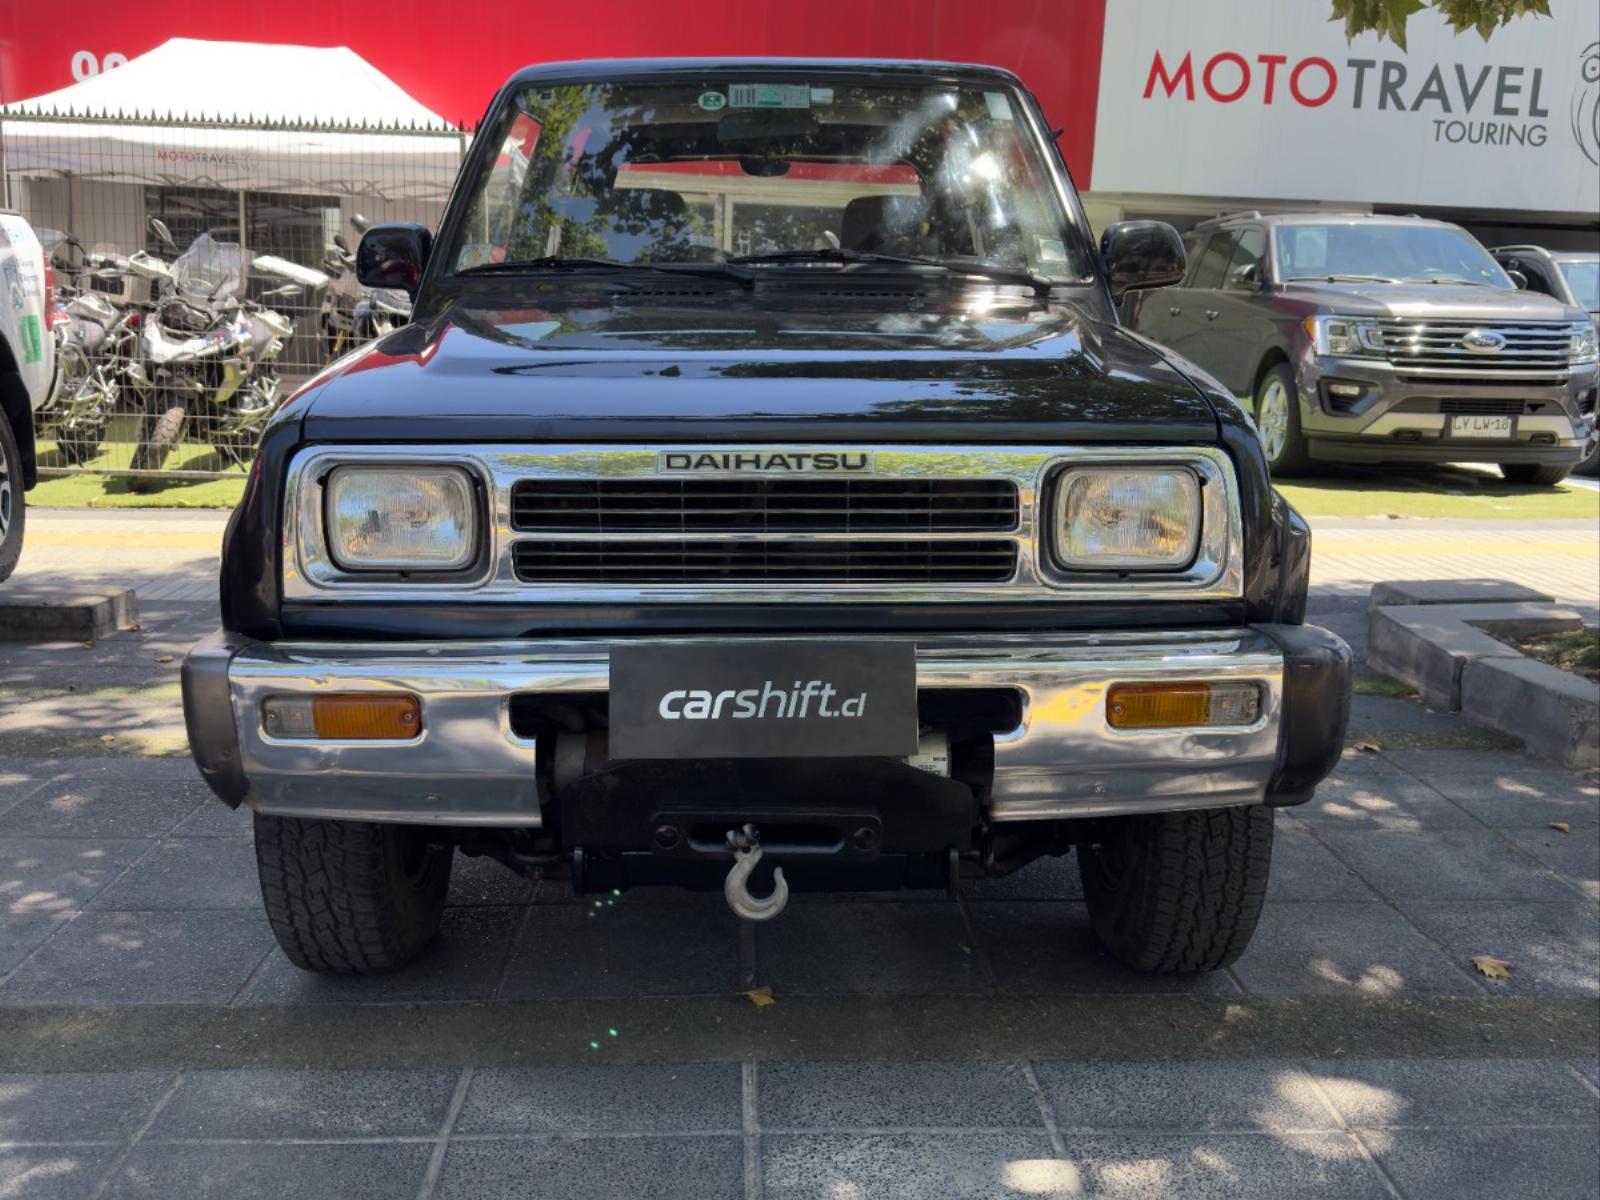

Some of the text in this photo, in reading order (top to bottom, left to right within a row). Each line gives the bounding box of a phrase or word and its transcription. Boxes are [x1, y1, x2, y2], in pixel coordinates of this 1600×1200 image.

[1143, 49, 1549, 118] MOTOTRAVEL
[1432, 119, 1549, 147] TOURING
[157, 150, 238, 165] MOTOTRAVEL
[665, 453, 868, 470] DAIHATSU
[658, 680, 867, 720] carshift.cl
